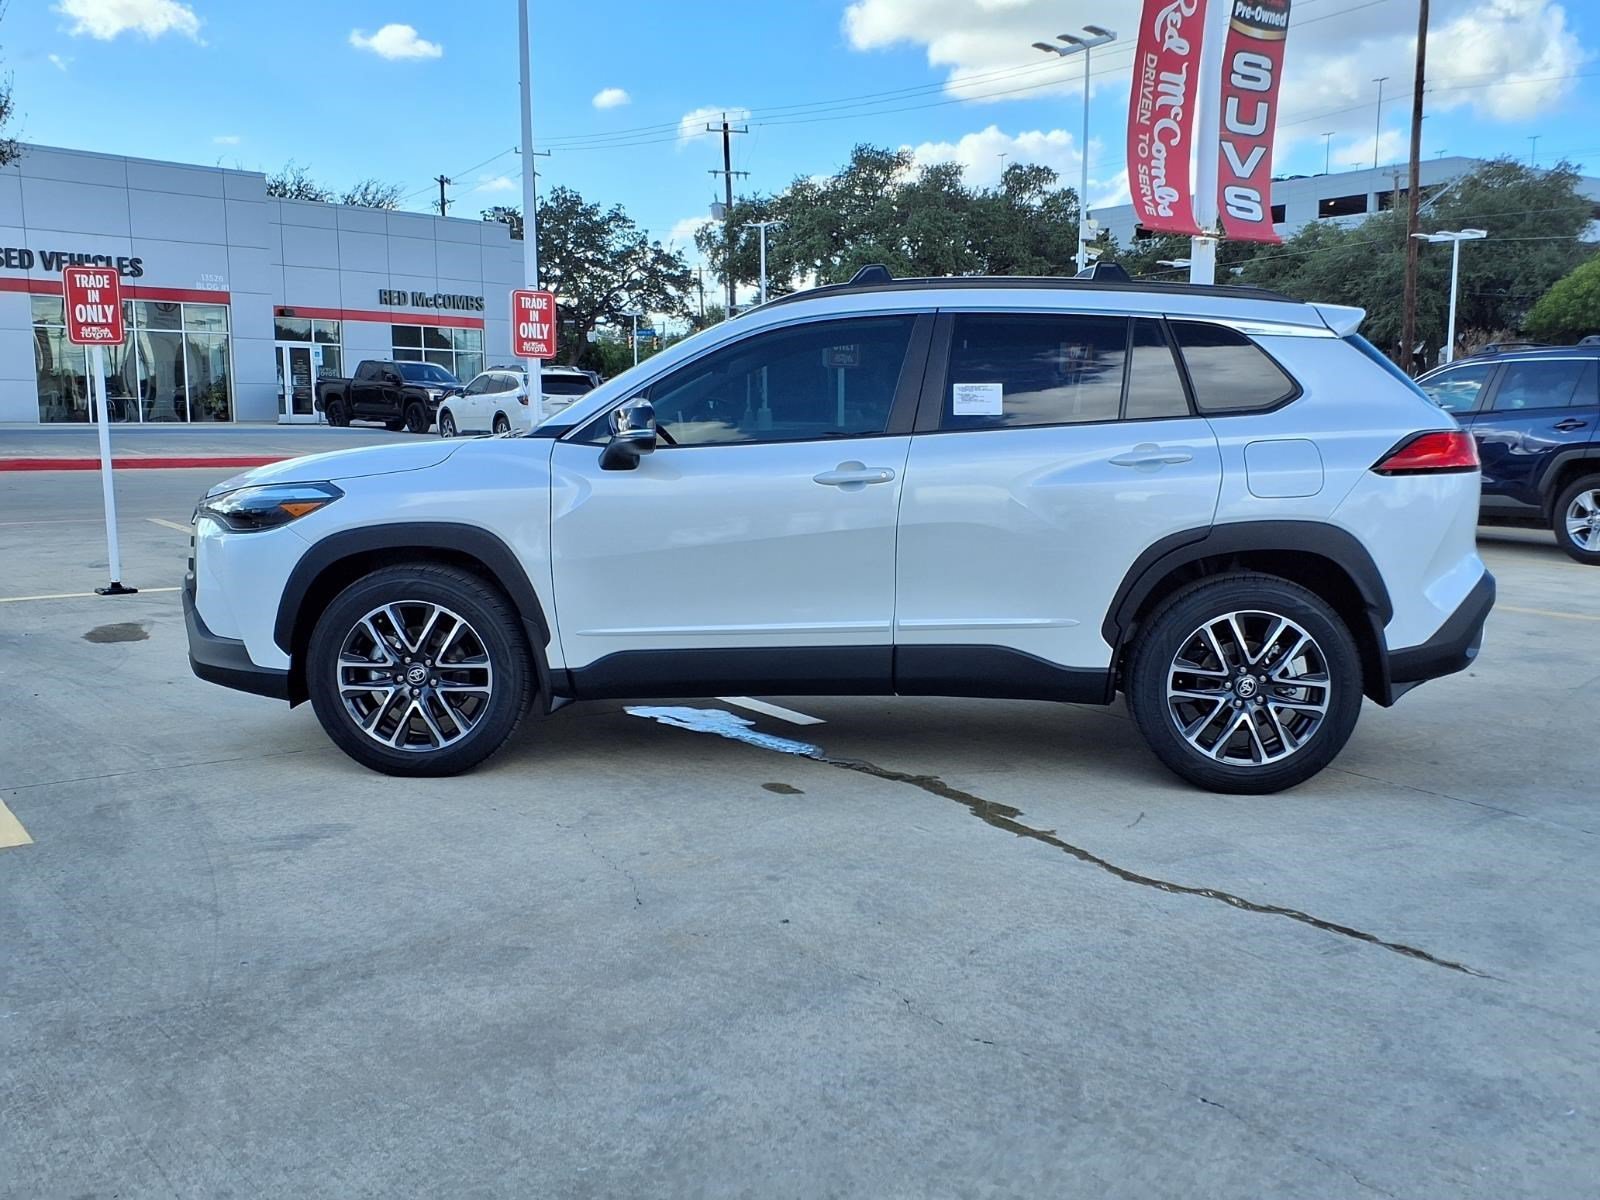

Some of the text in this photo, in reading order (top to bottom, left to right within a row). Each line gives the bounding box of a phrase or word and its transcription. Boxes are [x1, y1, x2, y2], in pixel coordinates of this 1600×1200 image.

[1234, 1, 1288, 27] Pre-Owned
[1138, 53, 1158, 217] DRIVEN TO SERVE
[1151, 62, 1189, 217] McCombs
[1220, 51, 1273, 223] SUVS
[74, 274, 110, 288] TRADE
[87, 289, 100, 303] IN
[379, 289, 485, 312] RED McCOMBS
[520, 296, 548, 310] TRADE
[75, 304, 114, 323] ONLY
[529, 309, 539, 322] IN
[519, 322, 550, 340] ONLY
[522, 345, 548, 353] TOYOTA
